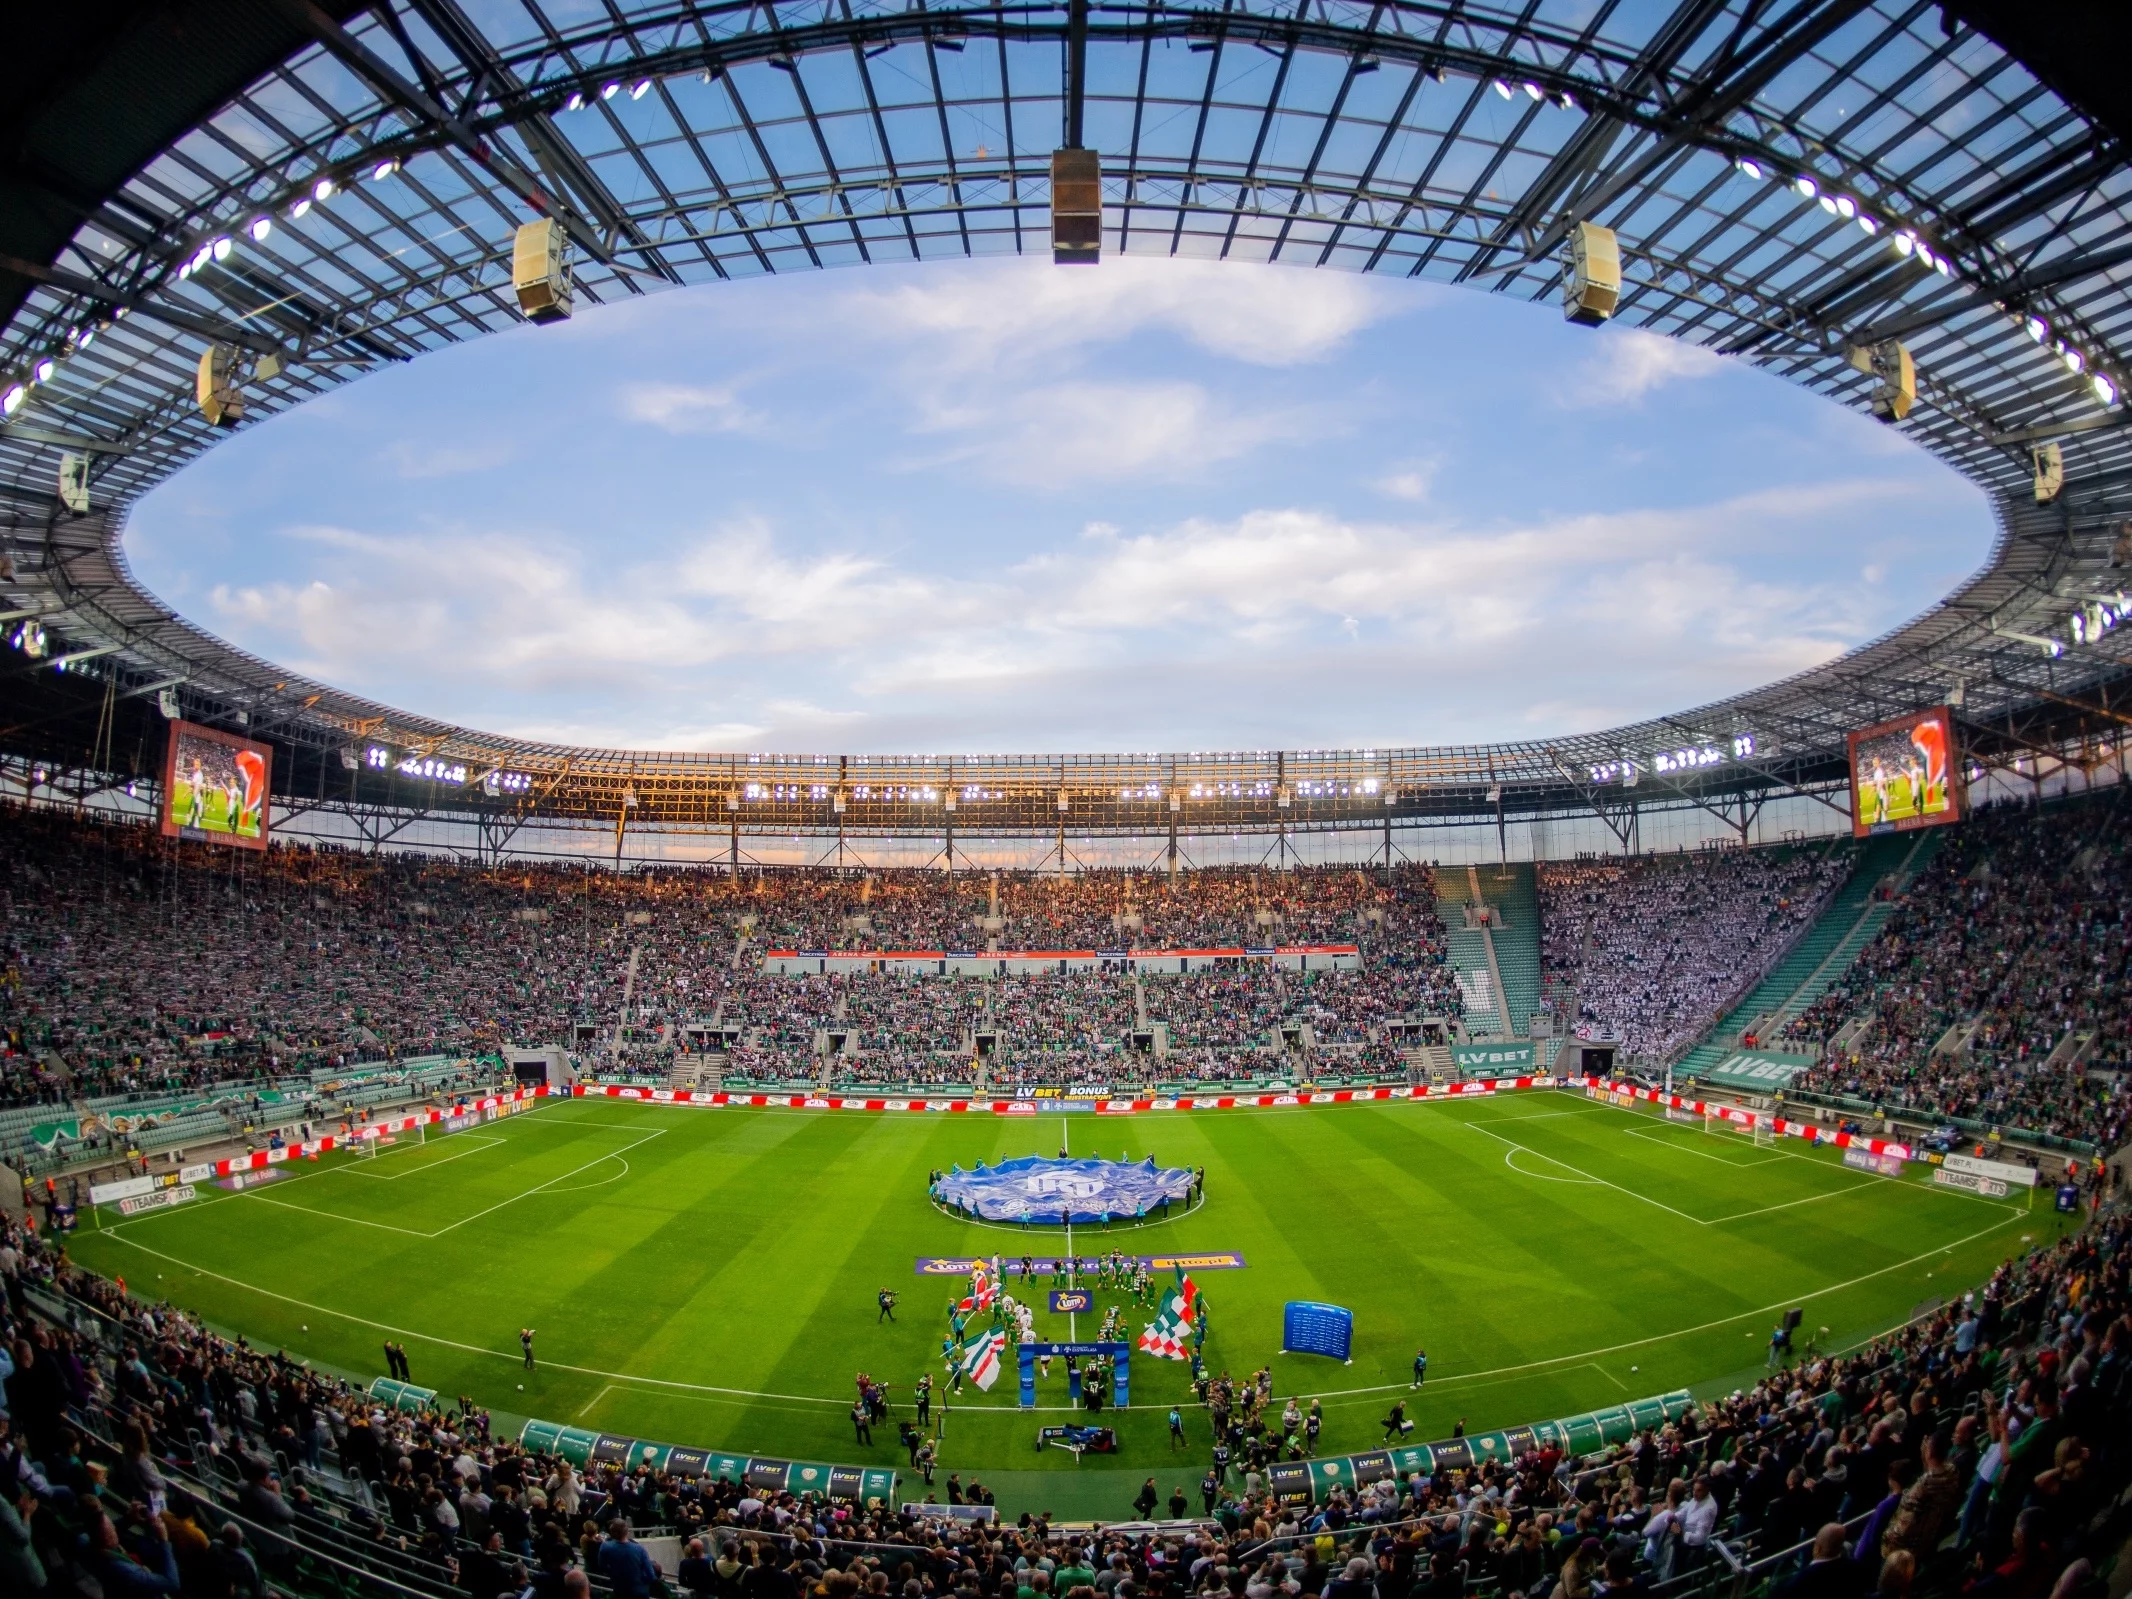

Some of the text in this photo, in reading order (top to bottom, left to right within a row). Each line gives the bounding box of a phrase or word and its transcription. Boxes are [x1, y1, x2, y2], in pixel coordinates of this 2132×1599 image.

[1069, 1086, 1109, 1095] BONUS
[1844, 1152, 1866, 1165] GRAJ
[1062, 1298, 1081, 1308] LOTTO
[1090, 1384, 1098, 1394] 47
[1508, 1432, 1532, 1440] LVBET
[602, 1440, 626, 1449] LVBET
[1438, 1446, 1462, 1454] LVBET
[675, 1453, 701, 1462] LVBET
[1358, 1458, 1384, 1467] LVBET
[754, 1464, 782, 1473] LVBET
[832, 1472, 861, 1481] LVBET
[1276, 1470, 1304, 1478] LVBET
[1280, 1493, 1307, 1501] LVBET
